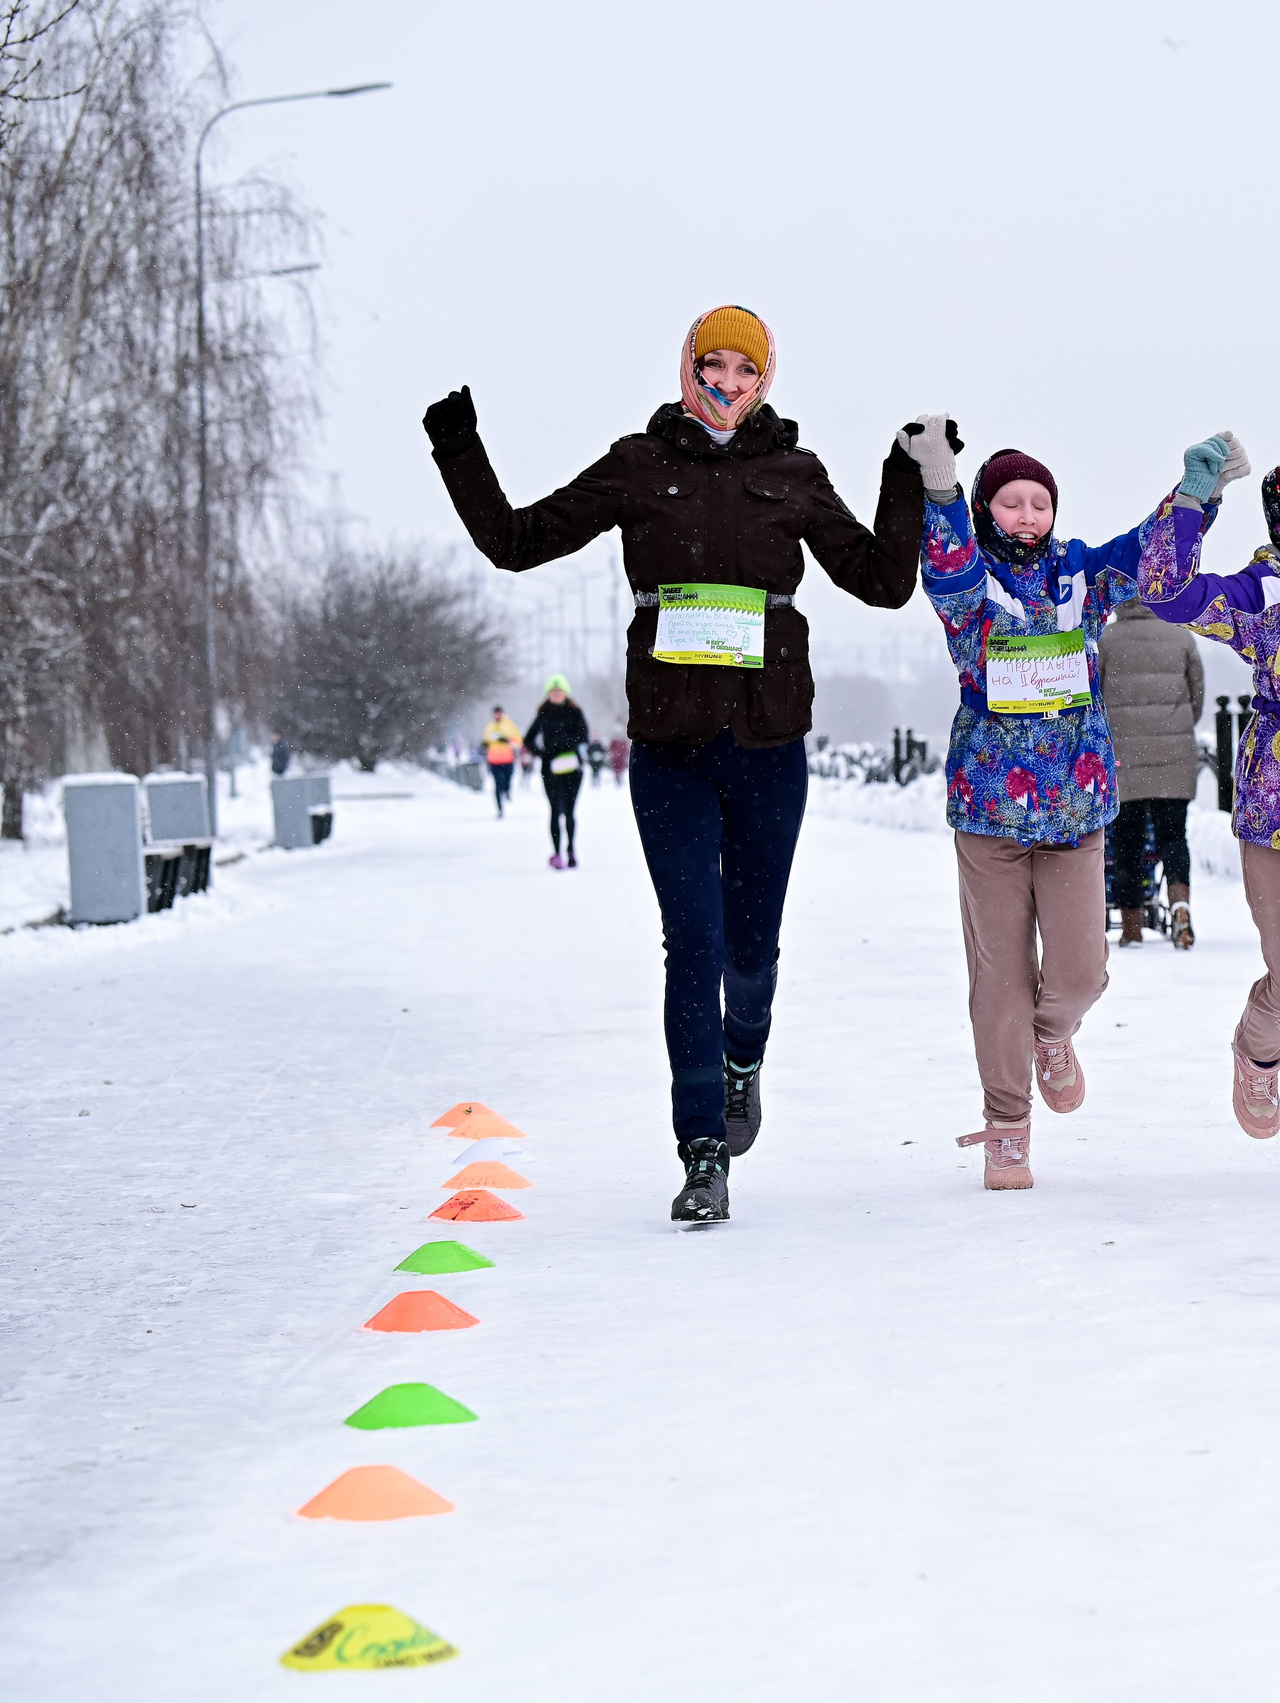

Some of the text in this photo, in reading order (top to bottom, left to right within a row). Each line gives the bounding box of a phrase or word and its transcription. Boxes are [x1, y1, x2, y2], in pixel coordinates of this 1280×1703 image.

[663, 591, 698, 600] ОБЕЩАНИЙ
[989, 644, 1027, 652] ОБЕЩАНИЙ
[1049, 689, 1071, 697] ОБЕЩАЮ
